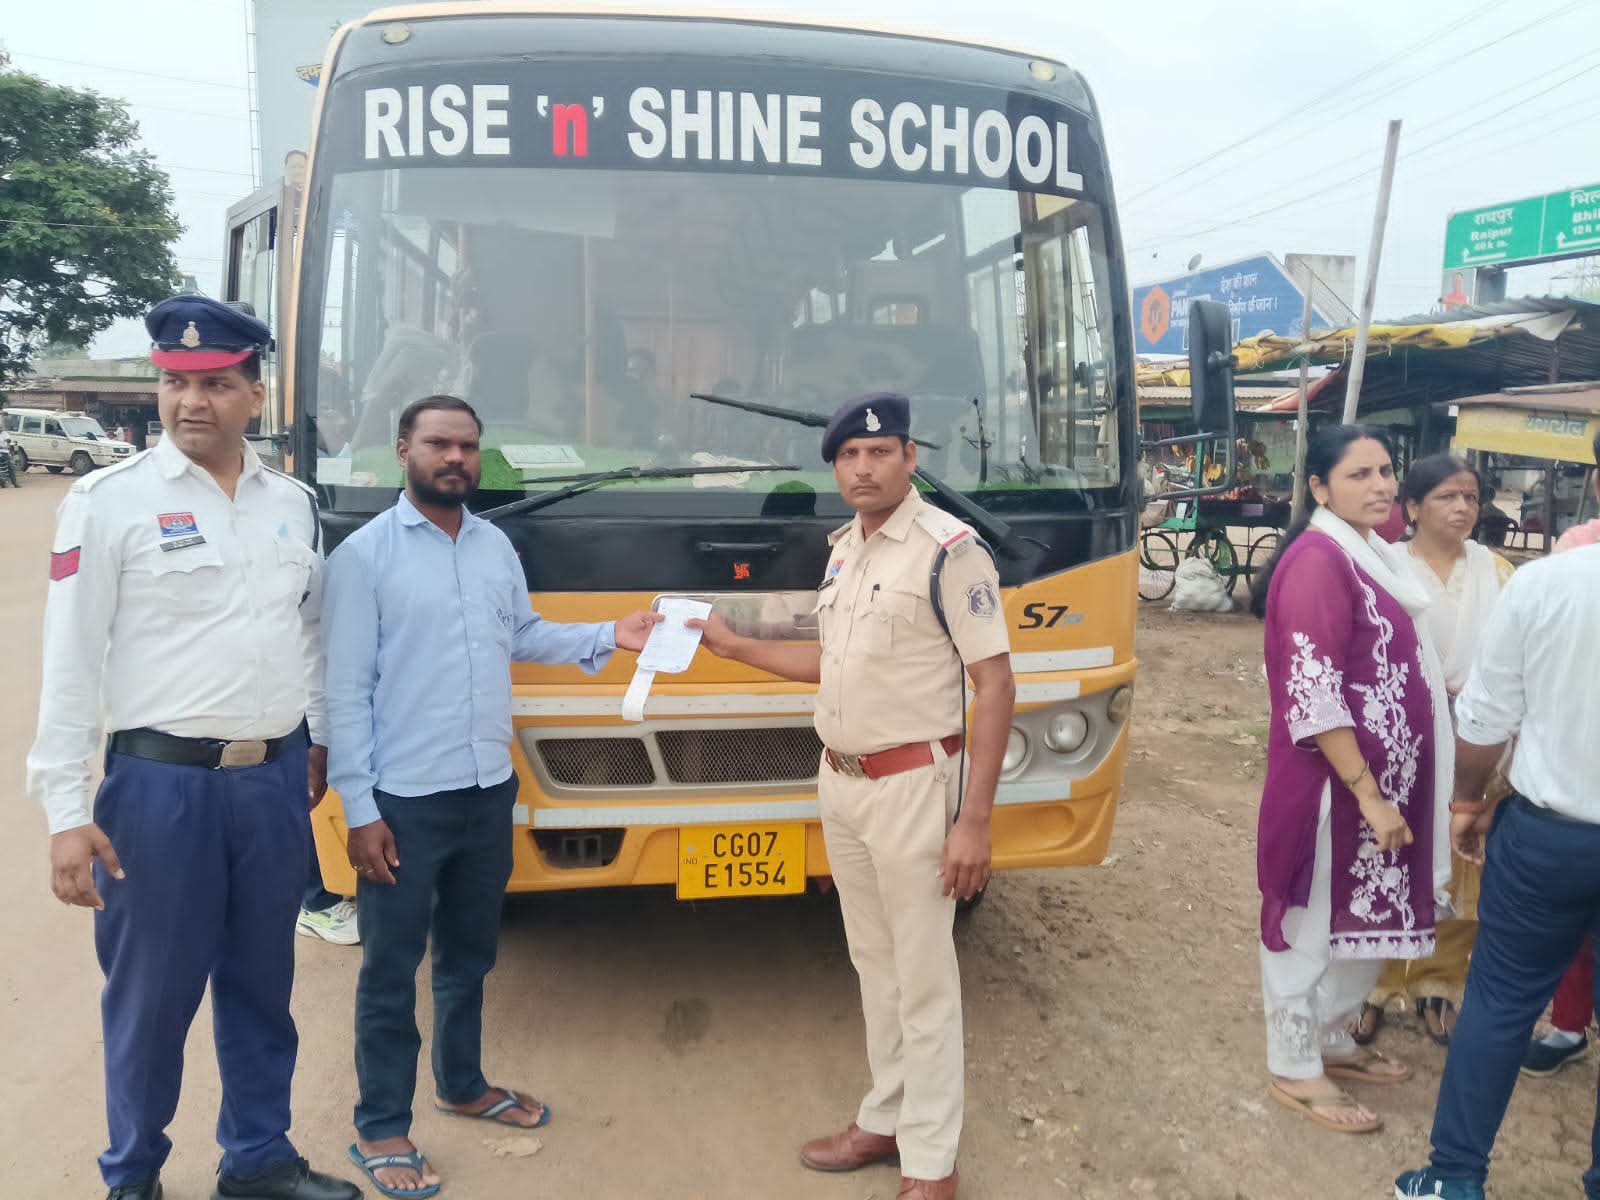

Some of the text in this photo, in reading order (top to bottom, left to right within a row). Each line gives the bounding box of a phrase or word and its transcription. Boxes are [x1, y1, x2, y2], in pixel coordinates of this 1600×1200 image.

[364, 84, 511, 161] RISE
[627, 86, 824, 167] SHINE
[850, 98, 1084, 192] SCHOOL
[1474, 208, 1514, 225] रायपुर
[1471, 227, 1512, 241] Raipur
[1018, 602, 1069, 629] S7
[713, 831, 778, 858] CG07
[704, 860, 786, 888] E1554
